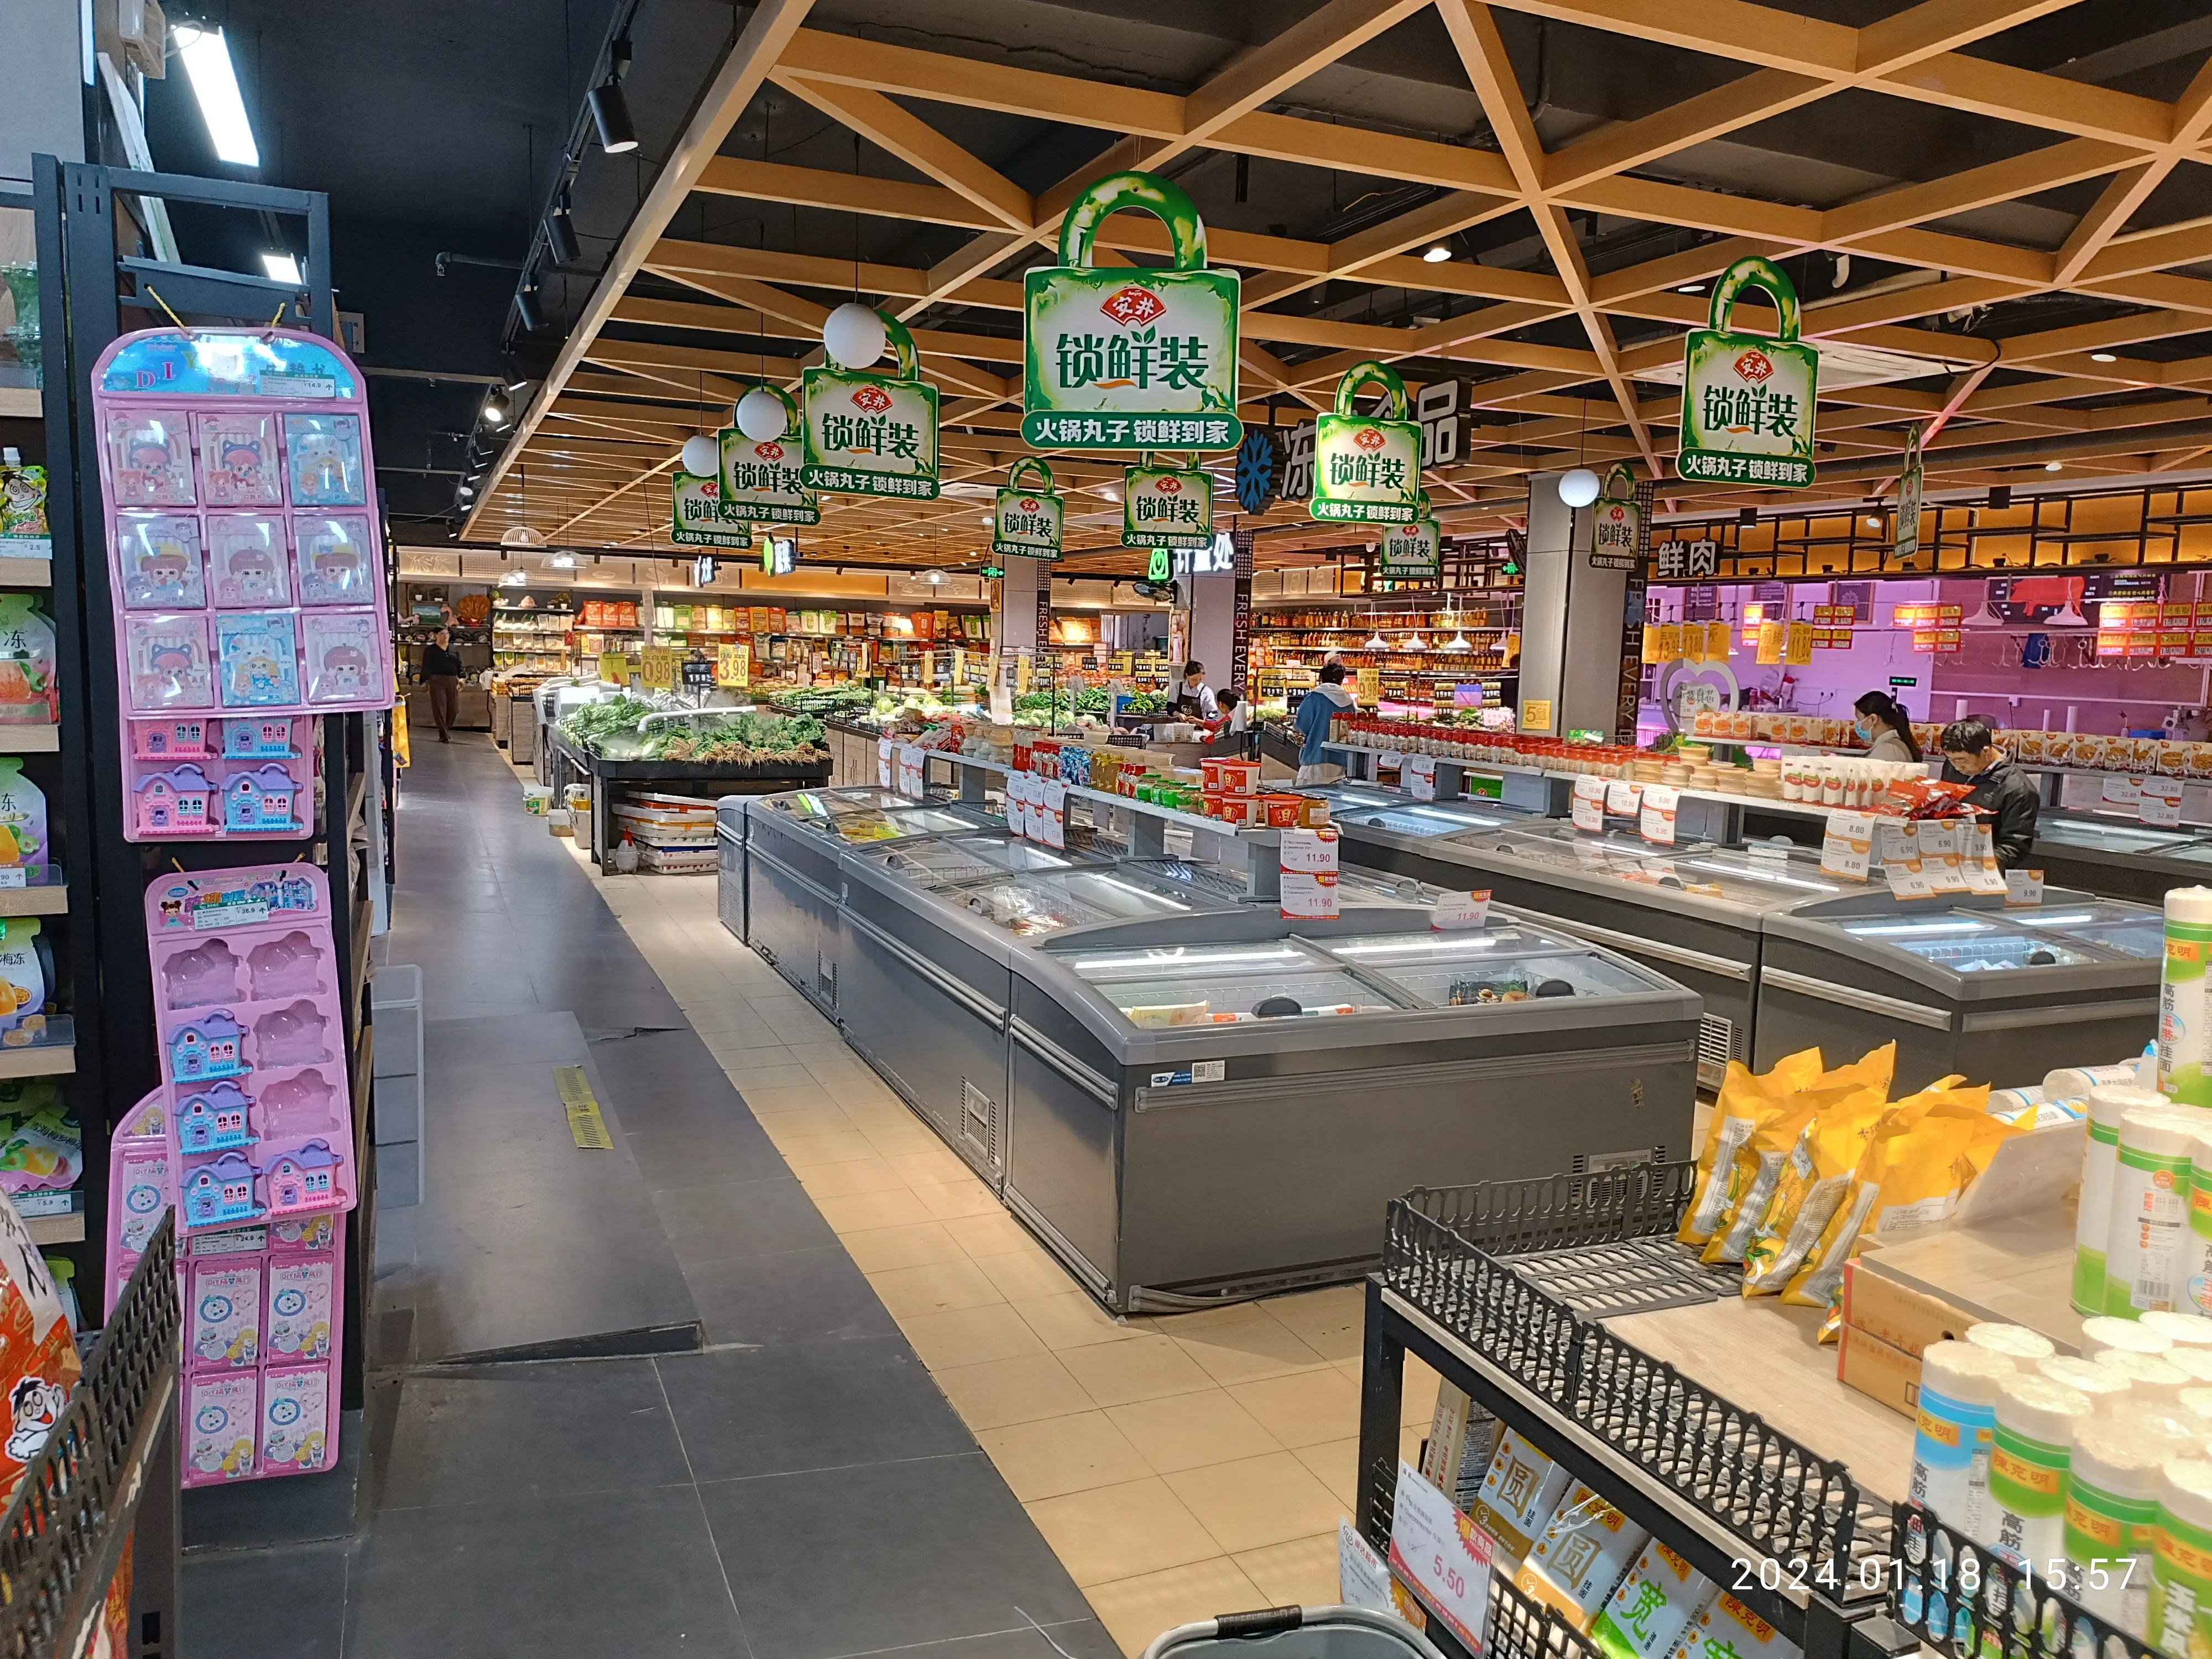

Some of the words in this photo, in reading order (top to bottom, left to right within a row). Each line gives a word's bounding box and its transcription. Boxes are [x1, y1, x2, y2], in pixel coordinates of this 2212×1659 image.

[1113, 296, 1155, 317] 安井
[1055, 328, 1209, 390] 锁鲜装
[1742, 358, 1767, 376] 安井
[859, 392, 886, 409] 安井
[1703, 386, 1798, 437] 锁鲜装
[822, 414, 920, 460] 锁鲜装
[1035, 419, 1130, 443] 火锅丸子
[1133, 419, 1230, 444] 锁鲜到家
[1281, 380, 1458, 498] 冻品
[1360, 432, 1381, 446] 安井
[760, 443, 780, 457] 安井
[1330, 453, 1405, 489] 锁鲜装
[1686, 456, 1746, 477] 火锅丸子
[1749, 458, 1808, 483] 锁鲜到家
[808, 468, 871, 490] 火锅丸子
[873, 476, 933, 497] 锁鲜到家
[684, 498, 721, 521] 锁鲜
[724, 503, 770, 520] 火锅丸子
[771, 507, 816, 524] 锁鲜到家
[1136, 497, 1199, 524] 锁鲜装
[1318, 503, 1365, 519] 火锅丸子
[1366, 504, 1413, 521] 锁鲜到家
[1004, 514, 1053, 538] 锁鲜装
[1598, 524, 1633, 547] 锁鲜装
[676, 531, 713, 544] 火锅丸子
[713, 535, 749, 547] 锁鲜到家
[1127, 534, 1166, 546] 火锅丸子
[1167, 536, 1208, 548] 锁鲜到家
[1390, 538, 1431, 557] 锁鲜装
[996, 542, 1027, 555] 火锅丸子
[1027, 546, 1058, 559] 锁鲜到家
[1657, 538, 1715, 578] 鲜肉
[1038, 602, 1049, 640] FRESH
[1235, 594, 1248, 645] FRESH
[1625, 578, 1644, 645] FRESH
[719, 658, 747, 680] 3.98
[1233, 649, 1246, 691] EVERY
[1359, 682, 1378, 700] 9.98
[1620, 655, 1639, 721] EVERY
[2157, 812, 2174, 820] 32.80
[1655, 827, 1667, 835] 9.90
[1849, 825, 1865, 834] 8.80
[1900, 846, 1913, 854] 6.90
[1938, 839, 1952, 848] 6.90
[1974, 843, 1987, 852] 9.90
[1306, 853, 1331, 863] 11.90
[1844, 860, 1861, 870] 8.80
[1910, 881, 1925, 889] 6.90
[1945, 875, 1960, 884] 9.90
[1308, 898, 1333, 908] 11.90
[2023, 889, 2037, 897] 9.90
[1457, 912, 1480, 921] 11.90
[1918, 1413, 1952, 1440] 克明
[1911, 1460, 1929, 1499] 高筋
[1524, 1508, 1536, 1528] 挂面
[1458, 1516, 1493, 1557] 爆款商品
[1998, 1509, 2026, 1552] 高筋
[1433, 1553, 1465, 1599] 5.50
[1578, 1579, 1593, 1600] 挂面
